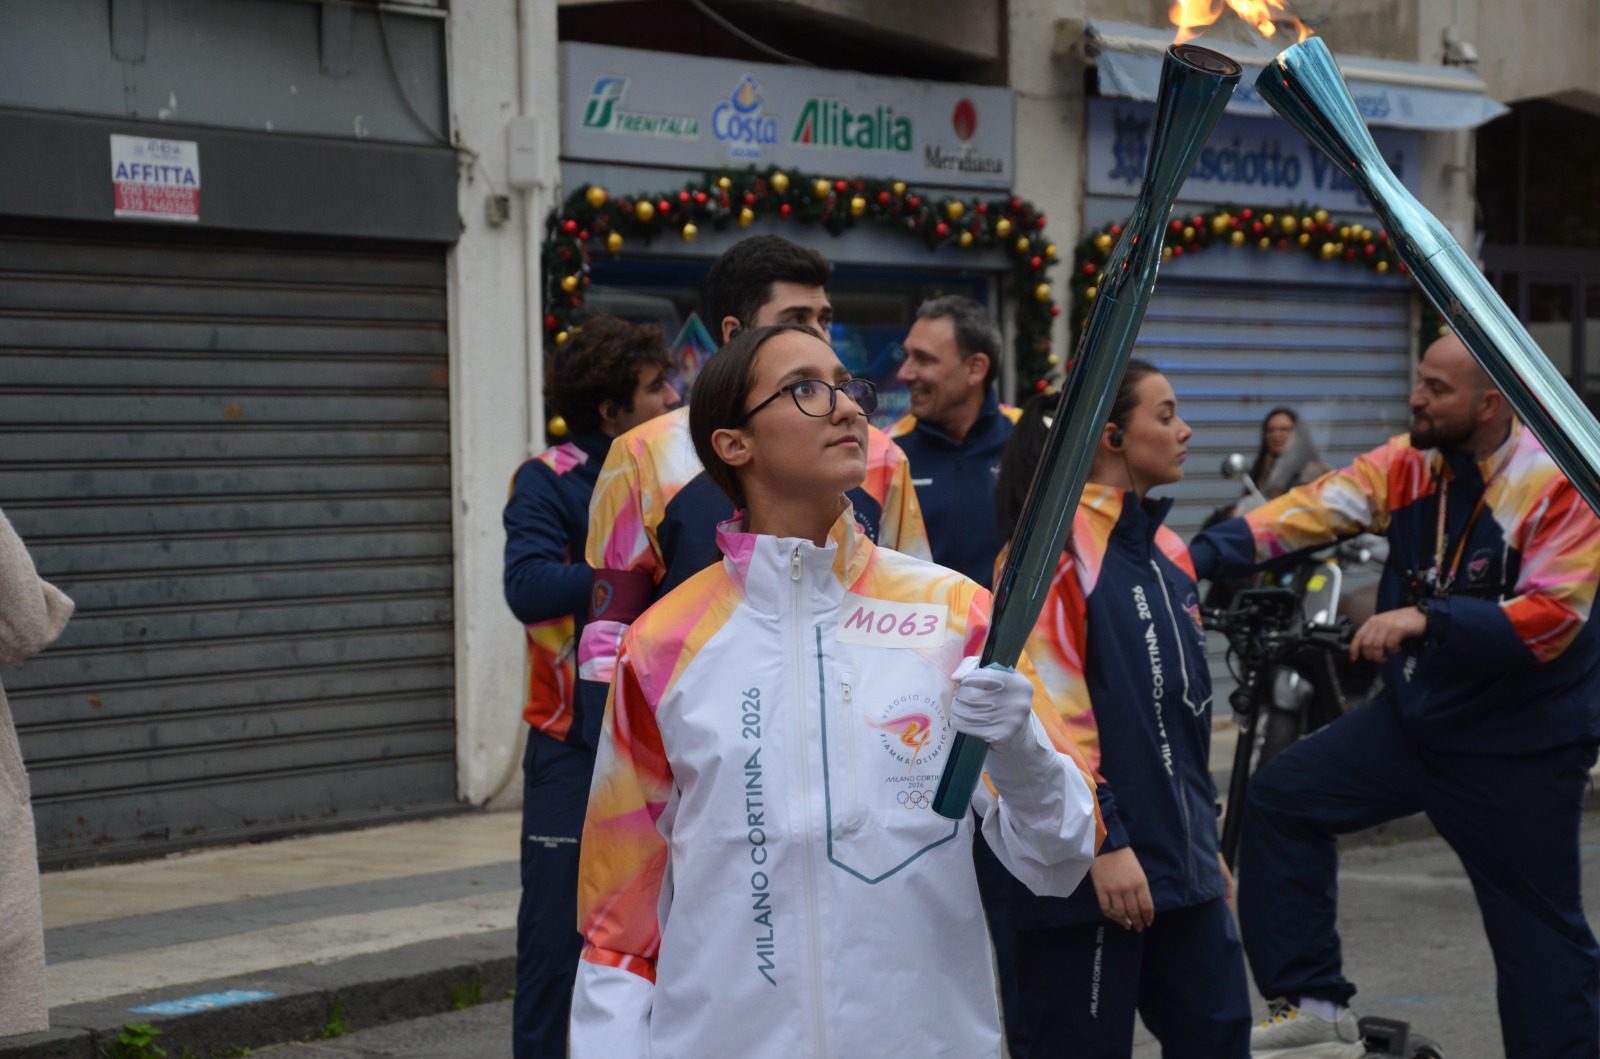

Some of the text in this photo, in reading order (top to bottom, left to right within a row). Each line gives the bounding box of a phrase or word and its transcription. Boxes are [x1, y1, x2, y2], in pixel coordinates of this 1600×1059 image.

[615, 113, 698, 136] TRENITALIA
[712, 103, 777, 145] Costa
[791, 98, 913, 151] Alitalia
[115, 161, 196, 185] AFFITTA
[924, 144, 1003, 174] Meridiana
[1131, 584, 1153, 621] 2026
[1144, 621, 1164, 700] CORTINA
[880, 694, 920, 720] VIAGGIO
[879, 732, 911, 766] FIAMMA
[884, 774, 939, 783] MILANO CORTI
[907, 781, 924, 789] 2026
[741, 686, 777, 987] MILANO CORTINA 2026
